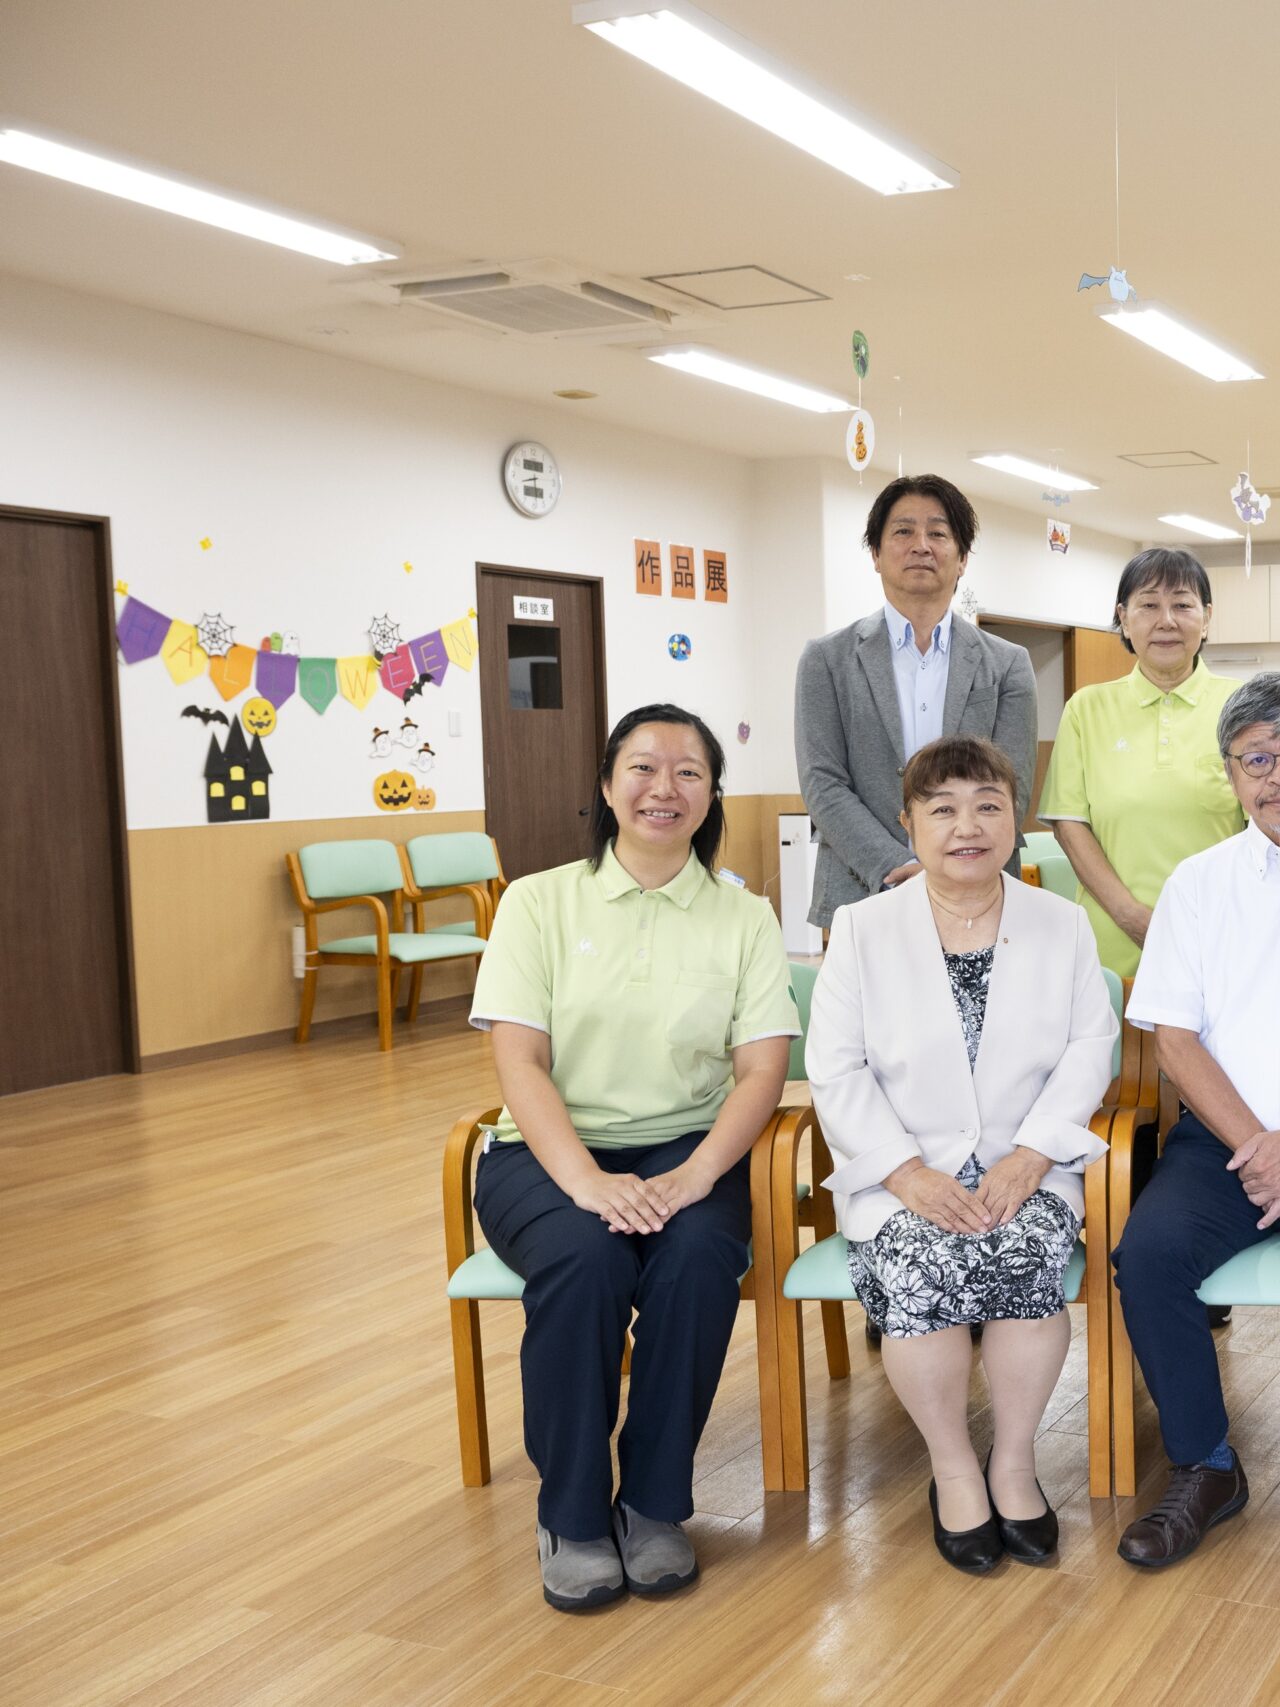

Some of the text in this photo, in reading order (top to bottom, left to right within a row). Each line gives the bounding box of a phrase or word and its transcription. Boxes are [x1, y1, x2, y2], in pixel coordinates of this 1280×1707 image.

[636, 550, 728, 592] 作品展
[519, 601, 549, 615] 相談室
